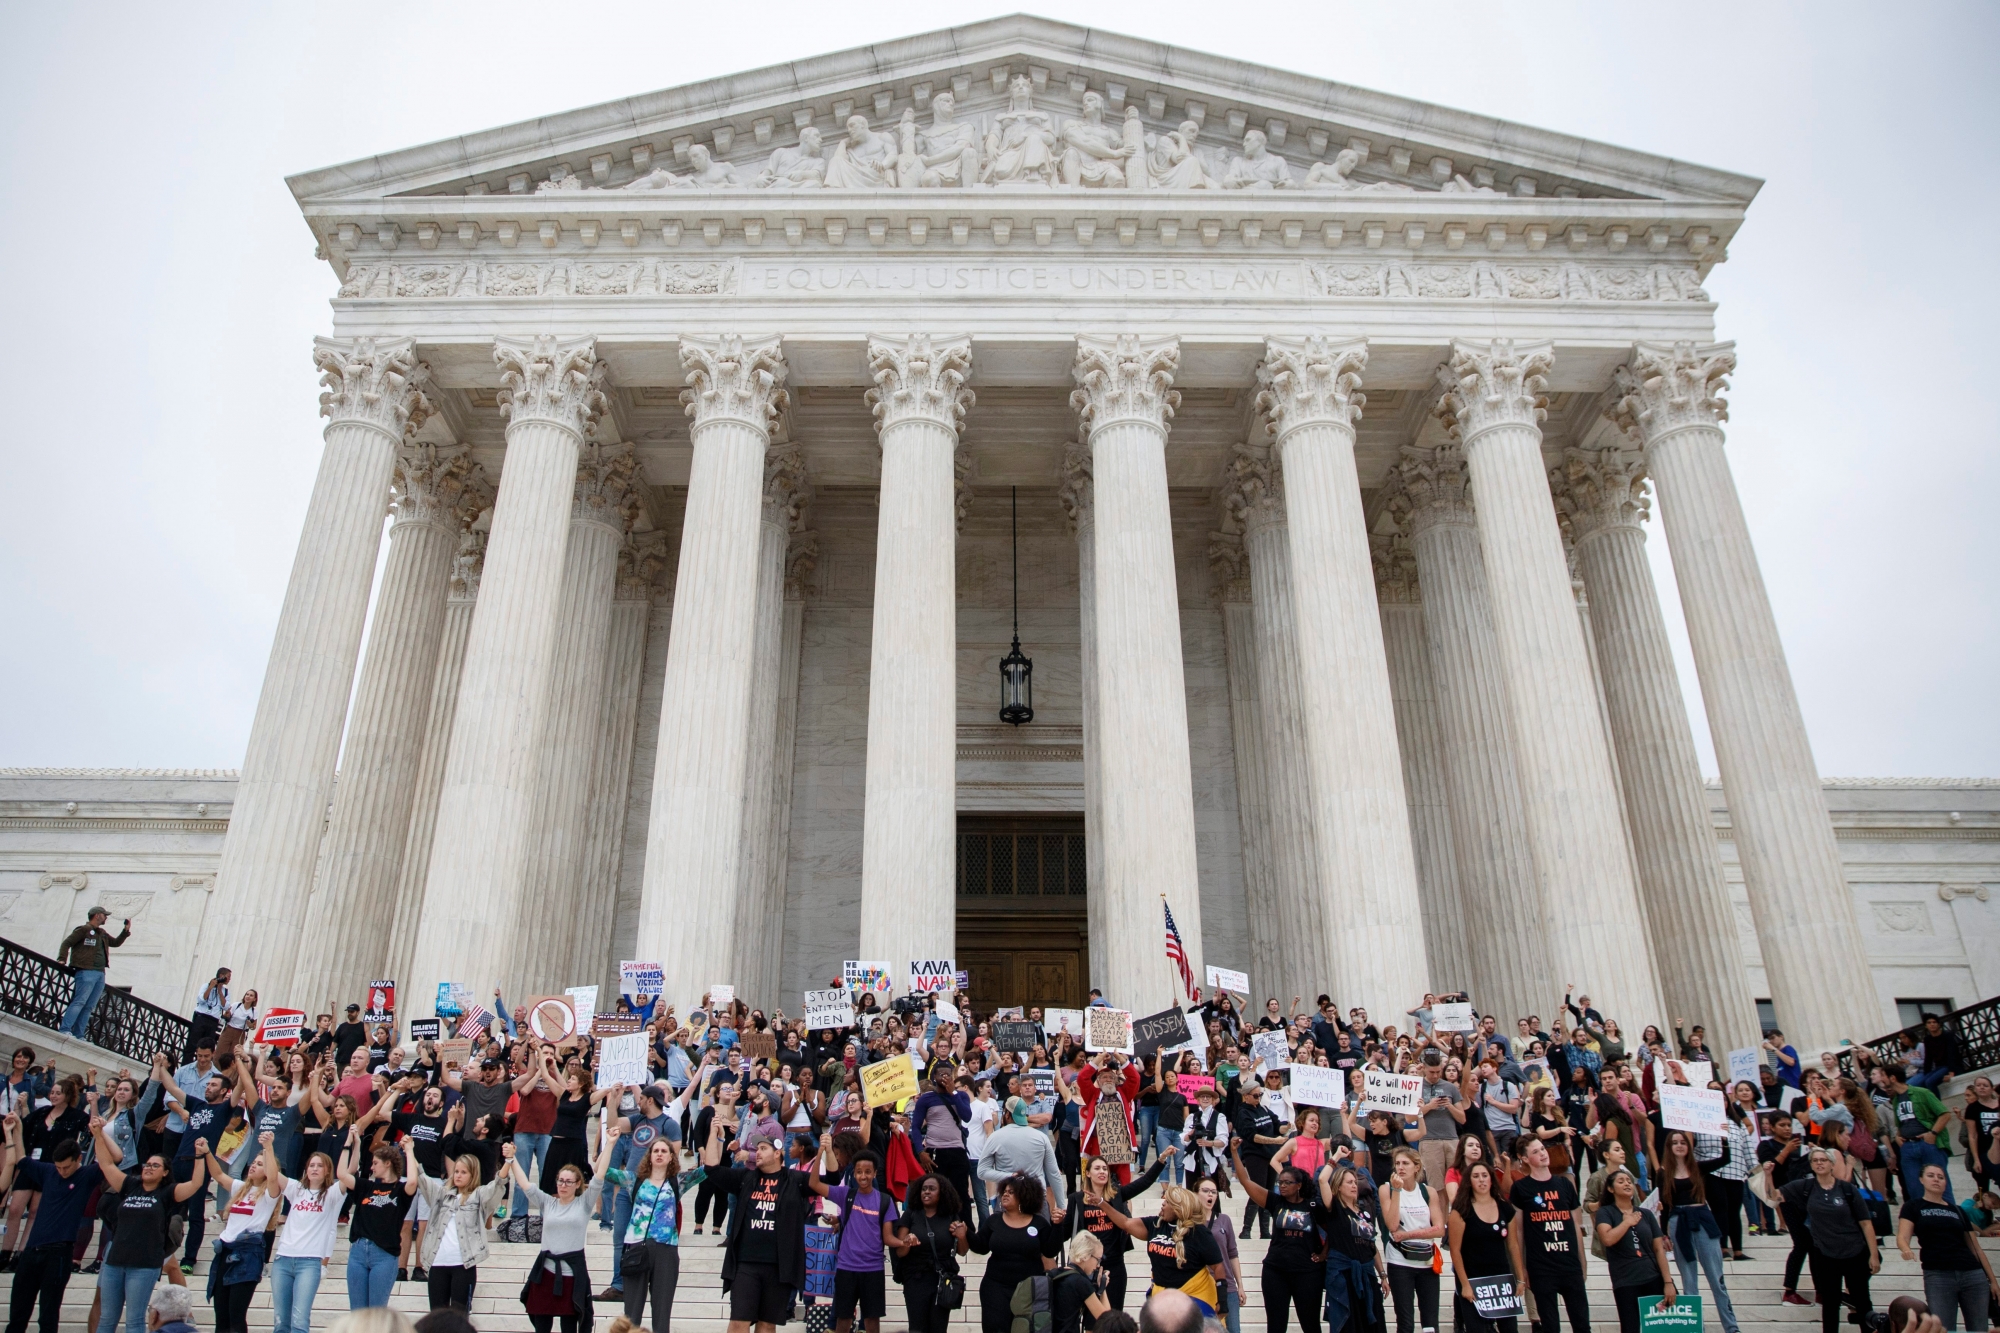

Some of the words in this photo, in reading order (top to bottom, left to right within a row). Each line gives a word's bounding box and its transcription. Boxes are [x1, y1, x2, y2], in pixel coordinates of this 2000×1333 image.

[764, 268, 892, 291] EQUAL
[900, 268, 1049, 291] JUSTICE
[1068, 268, 1199, 291] UNDER
[1209, 269, 1281, 291] LAW
[846, 969, 882, 978] BELIEVE
[911, 961, 951, 975] KAVA
[636, 971, 663, 979] WOMEN
[636, 979, 664, 987] VICTIMS
[846, 977, 875, 985] WOMEN
[918, 976, 951, 992] NAH
[809, 989, 847, 1002] STOP
[806, 1002, 850, 1014] ENTITLED
[266, 1016, 290, 1026] DISSENT
[292, 1016, 300, 1024] IS
[364, 1014, 393, 1022] NOPE
[812, 1014, 843, 1026] MEN
[266, 1028, 296, 1038] PATRIOTIC
[995, 1023, 1014, 1035] WE
[1016, 1023, 1034, 1035] WILL
[995, 1035, 1035, 1050] REMEMBE
[602, 1036, 647, 1063] UNPAID
[1731, 1053, 1755, 1067] FAKE
[600, 1061, 645, 1084] PROTESTER
[1296, 1066, 1342, 1080] ASHAMED
[1369, 1075, 1381, 1087] We
[1386, 1078, 1399, 1088] will
[1401, 1080, 1420, 1091] NOT
[1298, 1088, 1336, 1102] SENATE
[1661, 1085, 1684, 1096] SENATE
[1367, 1090, 1377, 1102] be
[1381, 1093, 1412, 1106] silent!
[1663, 1097, 1676, 1107] THE
[1680, 1099, 1699, 1109] TRUTH
[1096, 1104, 1121, 1113] MAK
[1100, 1146, 1121, 1154] WITH
[765, 1178, 779, 1187] AM
[765, 1186, 770, 1194] A
[1544, 1190, 1559, 1200] AM
[751, 1191, 779, 1202] URVIV
[756, 1201, 775, 1211] AND
[1547, 1201, 1554, 1210] A
[762, 1210, 766, 1220] I
[751, 1219, 775, 1230] VOTE
[1545, 1221, 1564, 1231] AND
[1554, 1232, 1558, 1241] I
[1543, 1241, 1569, 1252] VOTE
[1476, 1284, 1499, 1299] LIES
[1501, 1283, 1512, 1296] OF
[1475, 1296, 1515, 1311] PATTERN
[1514, 1296, 1521, 1308] A
[1665, 1317, 1688, 1327] fighting
